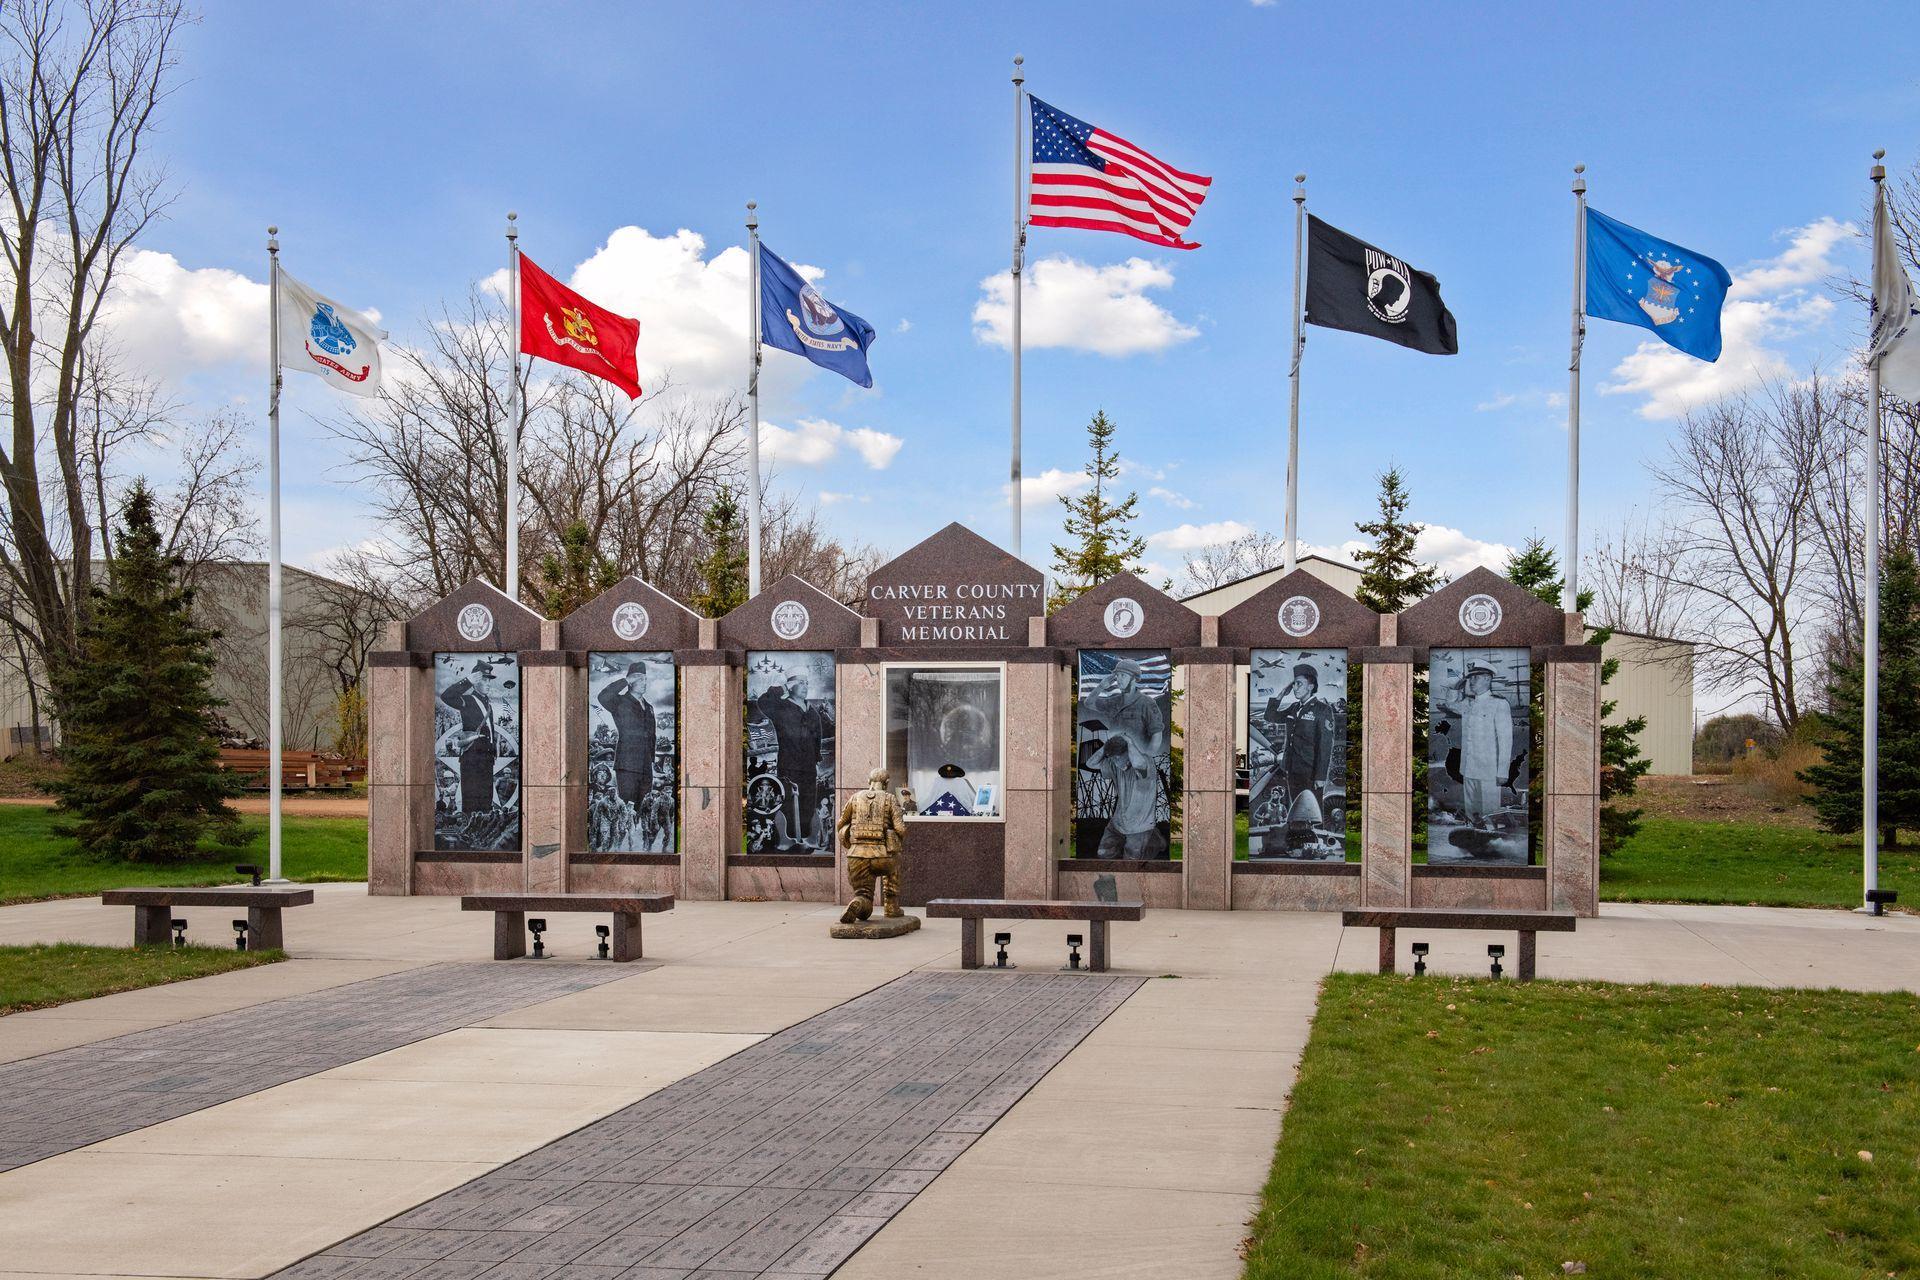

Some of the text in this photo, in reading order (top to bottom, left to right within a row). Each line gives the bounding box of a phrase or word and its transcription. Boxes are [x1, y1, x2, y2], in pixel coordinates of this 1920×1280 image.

[1364, 248, 1412, 288] POW MIA
[810, 339, 824, 347] STATES
[340, 369, 362, 381] ARMY
[870, 584, 1041, 600] CARVER COUNTY
[904, 604, 1006, 620] VETERANS
[902, 626, 1010, 641] MEMORIAL
